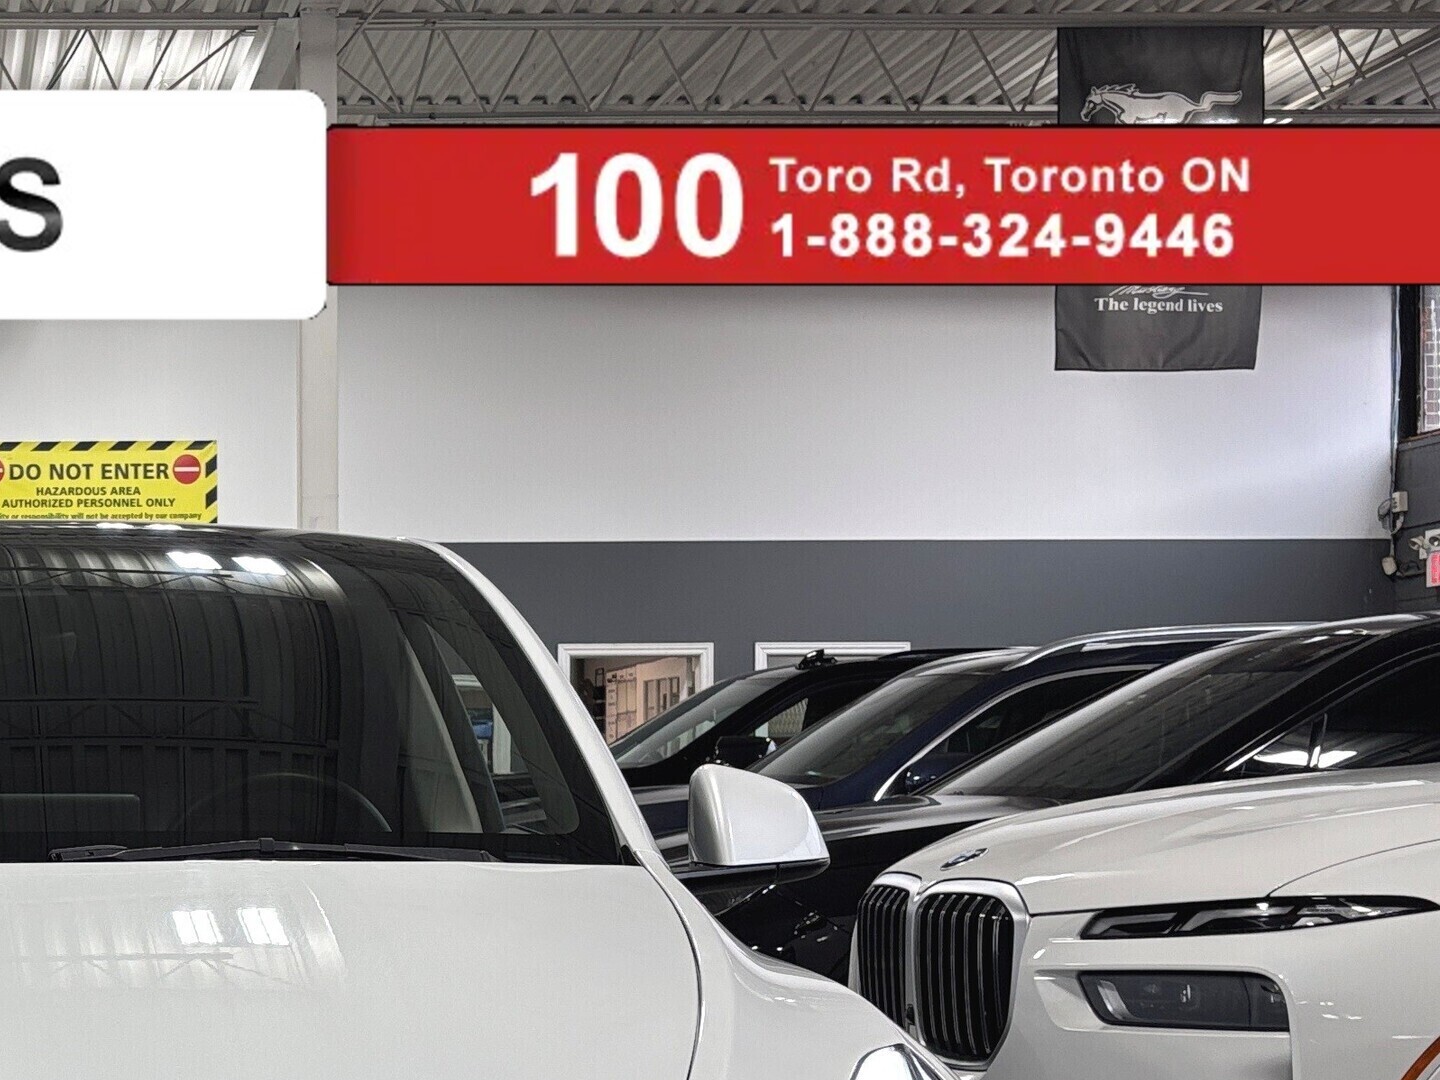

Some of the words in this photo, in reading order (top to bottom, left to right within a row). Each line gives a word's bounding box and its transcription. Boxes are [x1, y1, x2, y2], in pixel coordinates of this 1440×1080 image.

[1094, 297, 1129, 312] The
[1133, 298, 1184, 315] legend
[1187, 299, 1224, 313] lives
[9, 463, 42, 480] DO
[49, 463, 94, 480] NOT
[100, 463, 170, 480] ENTER
[35, 486, 108, 496] HAZARDOUS
[110, 486, 142, 496] AREA
[1, 499, 74, 508] AUTHORIZED
[76, 498, 143, 508] PERSONNEL
[145, 498, 176, 508] ONLY
